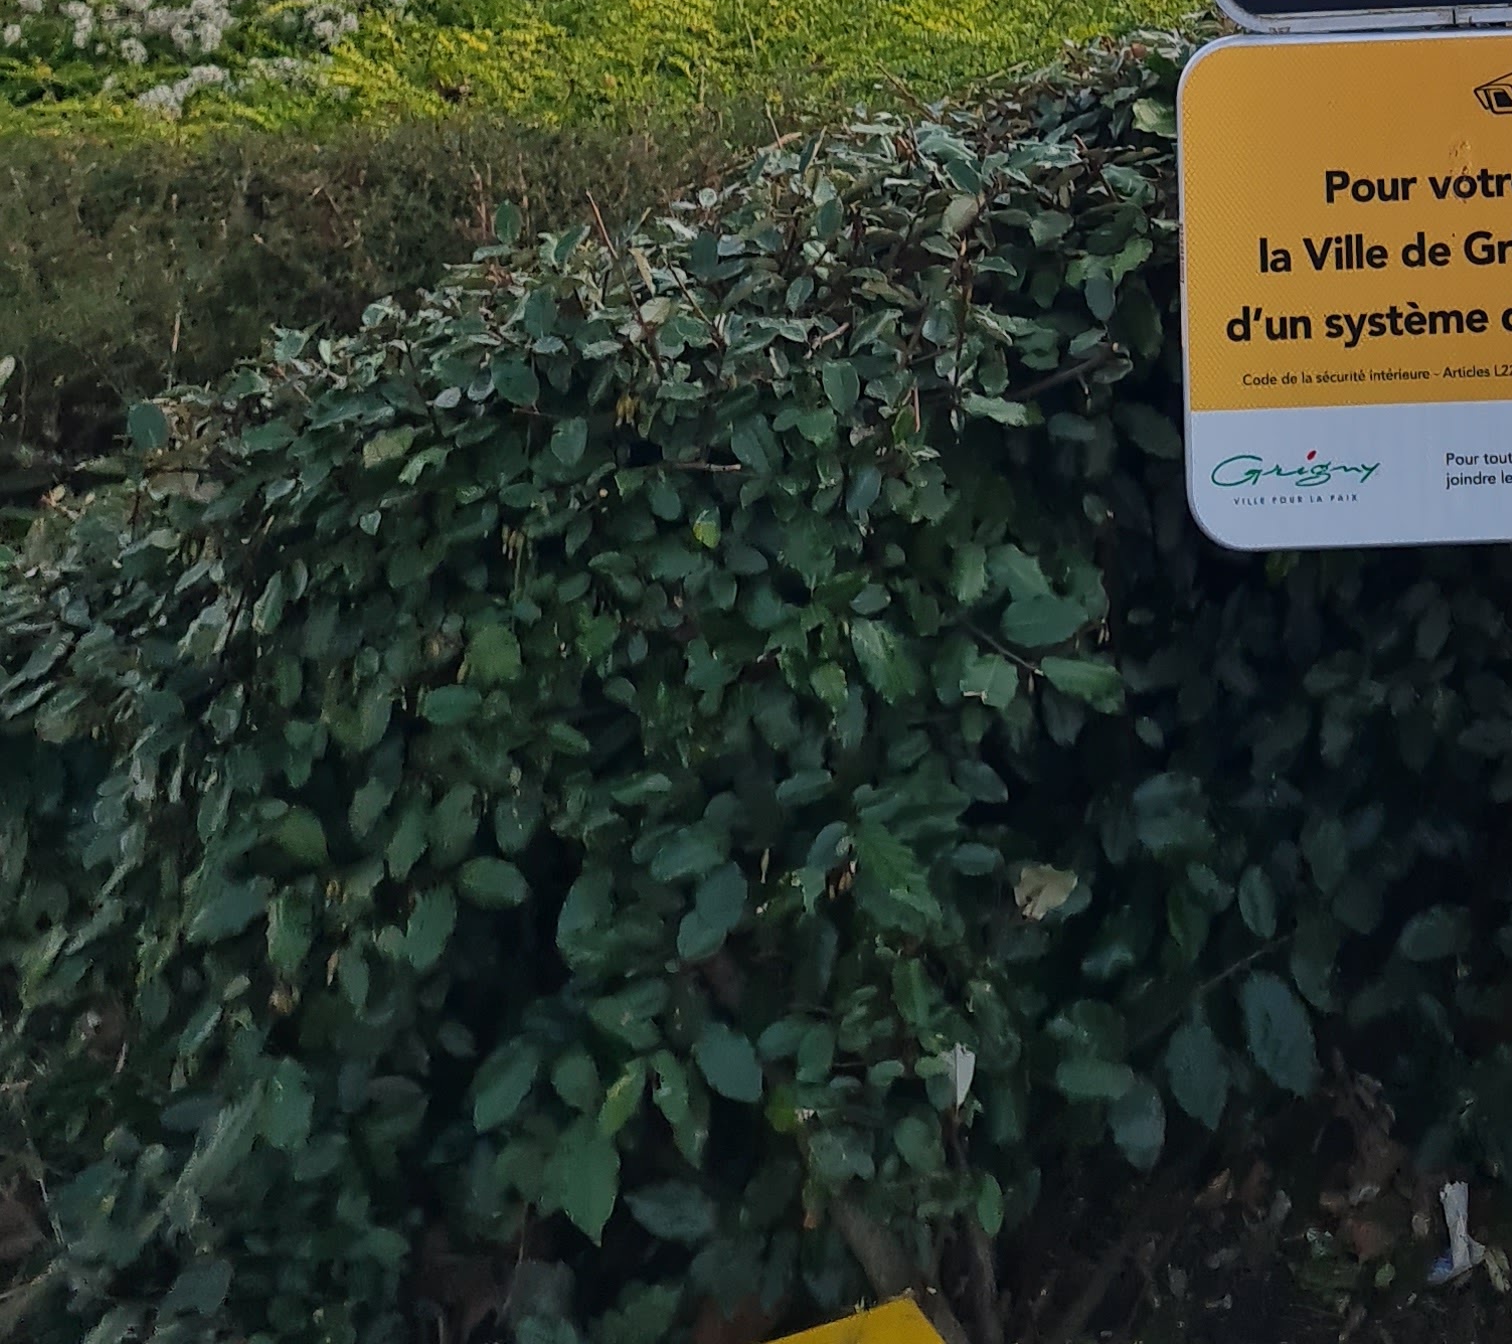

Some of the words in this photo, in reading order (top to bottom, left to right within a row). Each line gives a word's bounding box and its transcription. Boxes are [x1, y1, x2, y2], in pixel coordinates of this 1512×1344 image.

[1326, 171, 1417, 203] Pour
[1260, 238, 1291, 272] la
[1303, 234, 1388, 270] Ville
[1402, 232, 1451, 267] de
[1325, 302, 1489, 348] système
[1242, 372, 1278, 386] Code
[1281, 371, 1298, 385] de
[1301, 371, 1313, 384] la
[1315, 369, 1366, 384] sécurité
[1369, 367, 1431, 381] intérieure
[1442, 365, 1491, 379] Articles
[1211, 450, 1380, 487] Grigny
[1446, 452, 1480, 466] Pour
[1446, 471, 1497, 490] joindre
